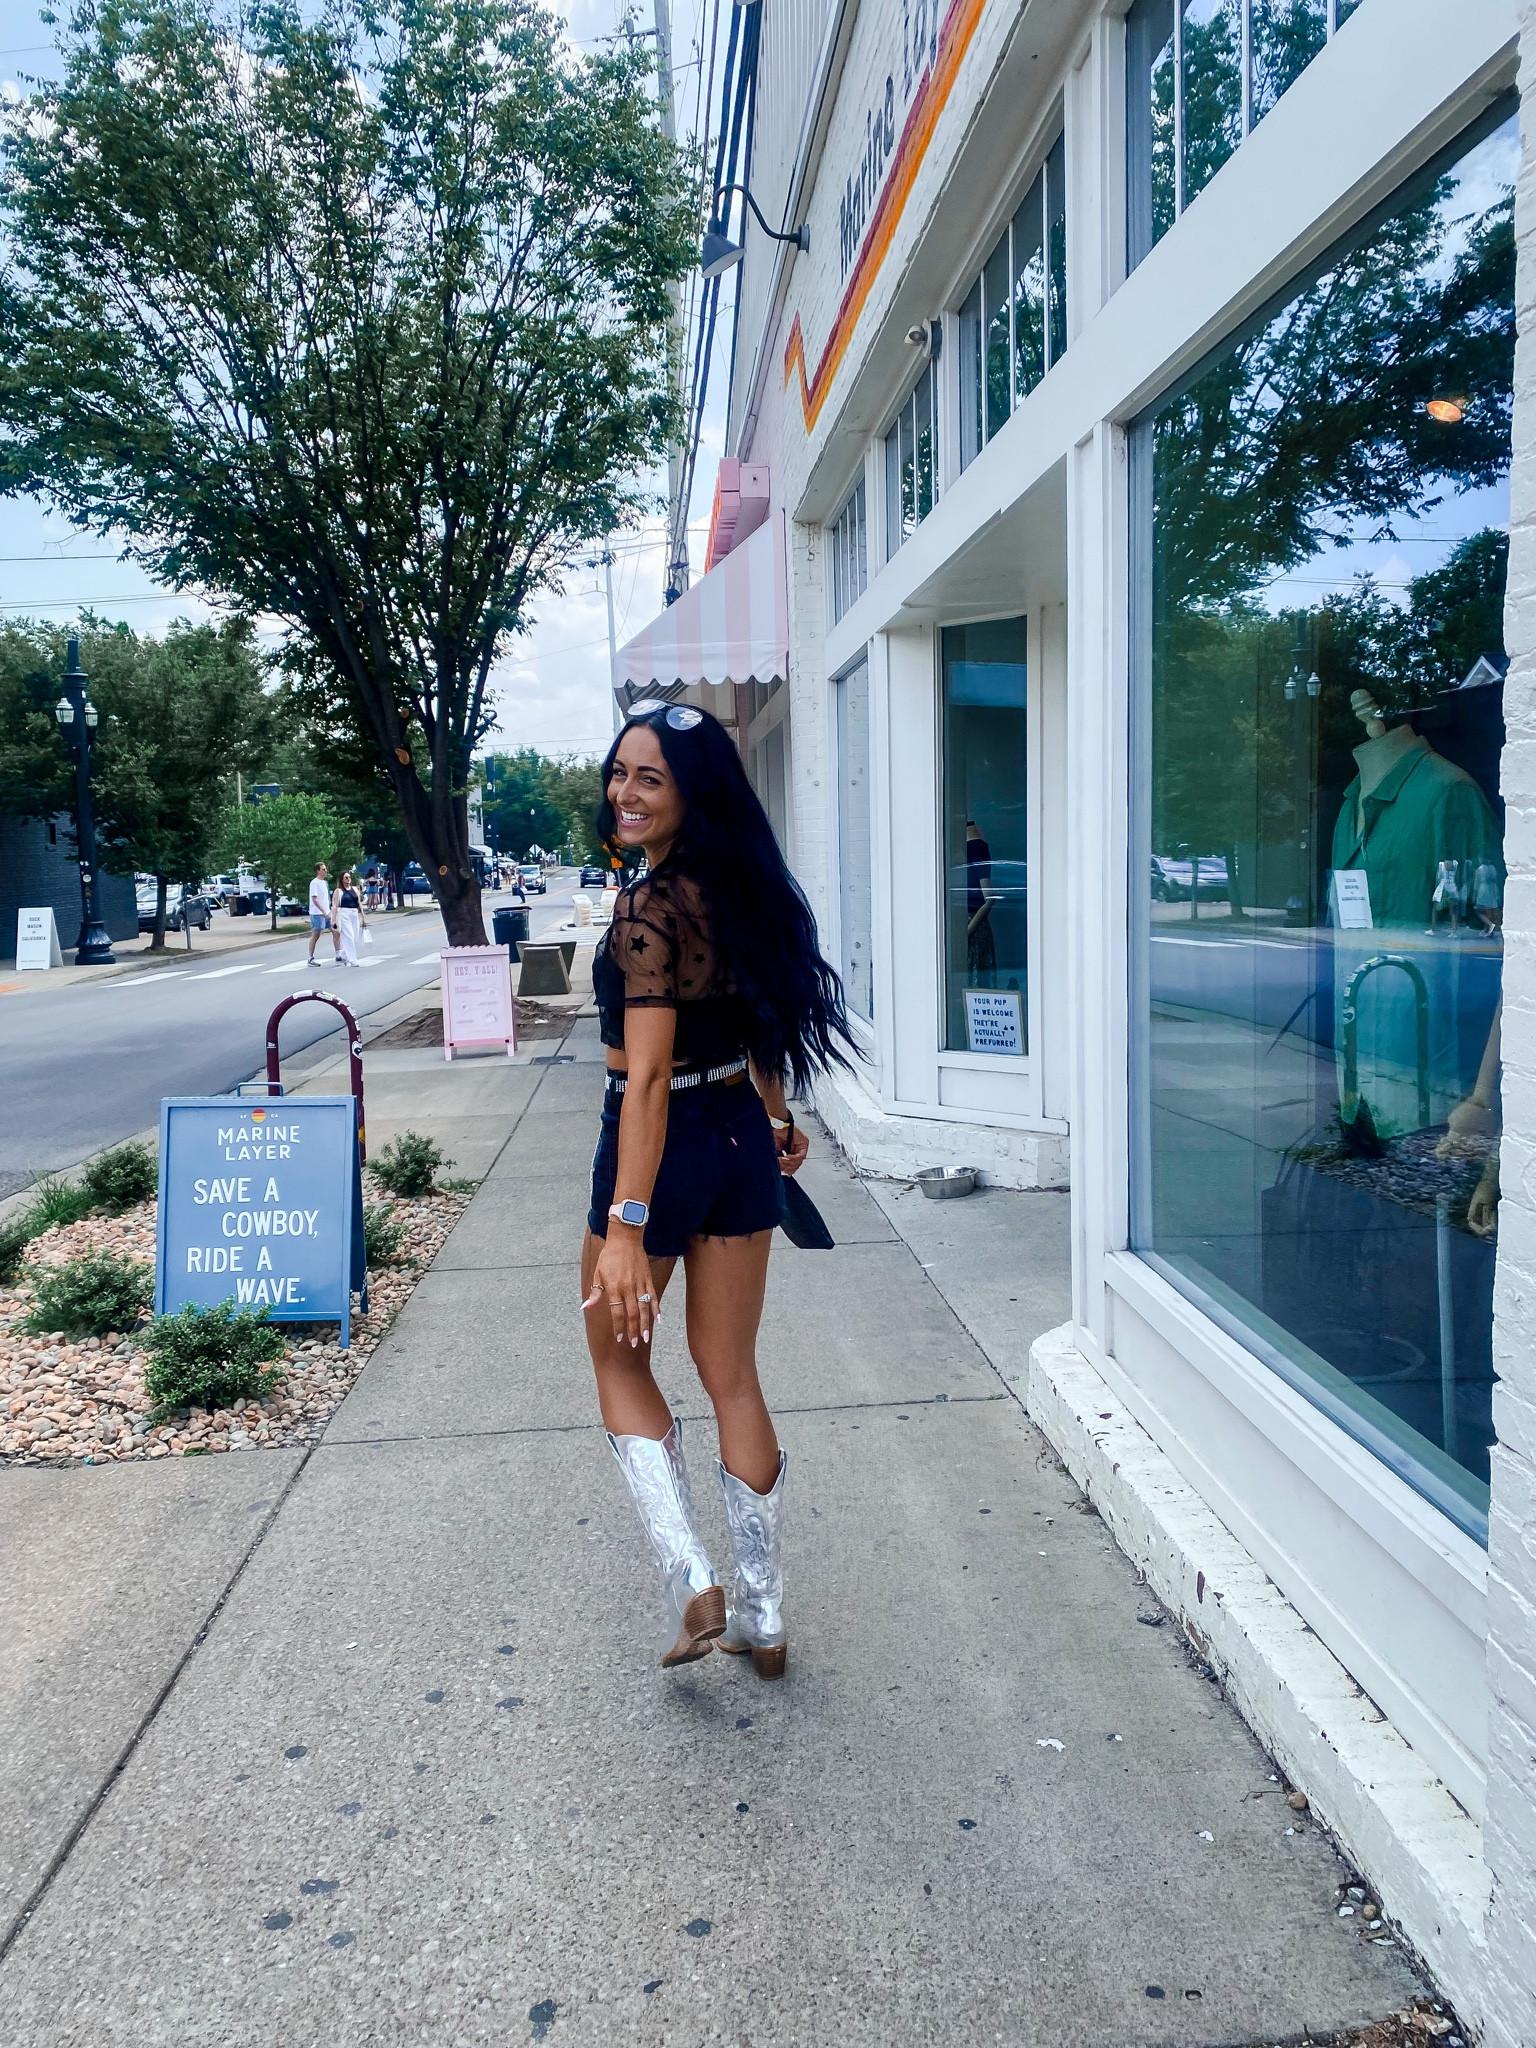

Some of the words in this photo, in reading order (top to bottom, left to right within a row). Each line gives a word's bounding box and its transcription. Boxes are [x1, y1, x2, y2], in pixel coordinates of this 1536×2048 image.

[840, 74, 895, 286] Marine
[994, 998, 1007, 1006] PUP
[982, 1009, 1013, 1017] WELCOME
[973, 1019, 998, 1027] THEY'RE
[974, 1029, 1006, 1037] ACTUALLY
[975, 1038, 1016, 1047] PREFURRED!
[218, 1125, 300, 1146] MARINE
[225, 1144, 292, 1162] LAYER
[193, 1177, 252, 1206] SAVE
[263, 1177, 281, 1203] A
[222, 1210, 319, 1238] COWBOY,
[186, 1245, 244, 1274] RIDE
[256, 1245, 273, 1272] A
[235, 1277, 307, 1305] WAVE.
